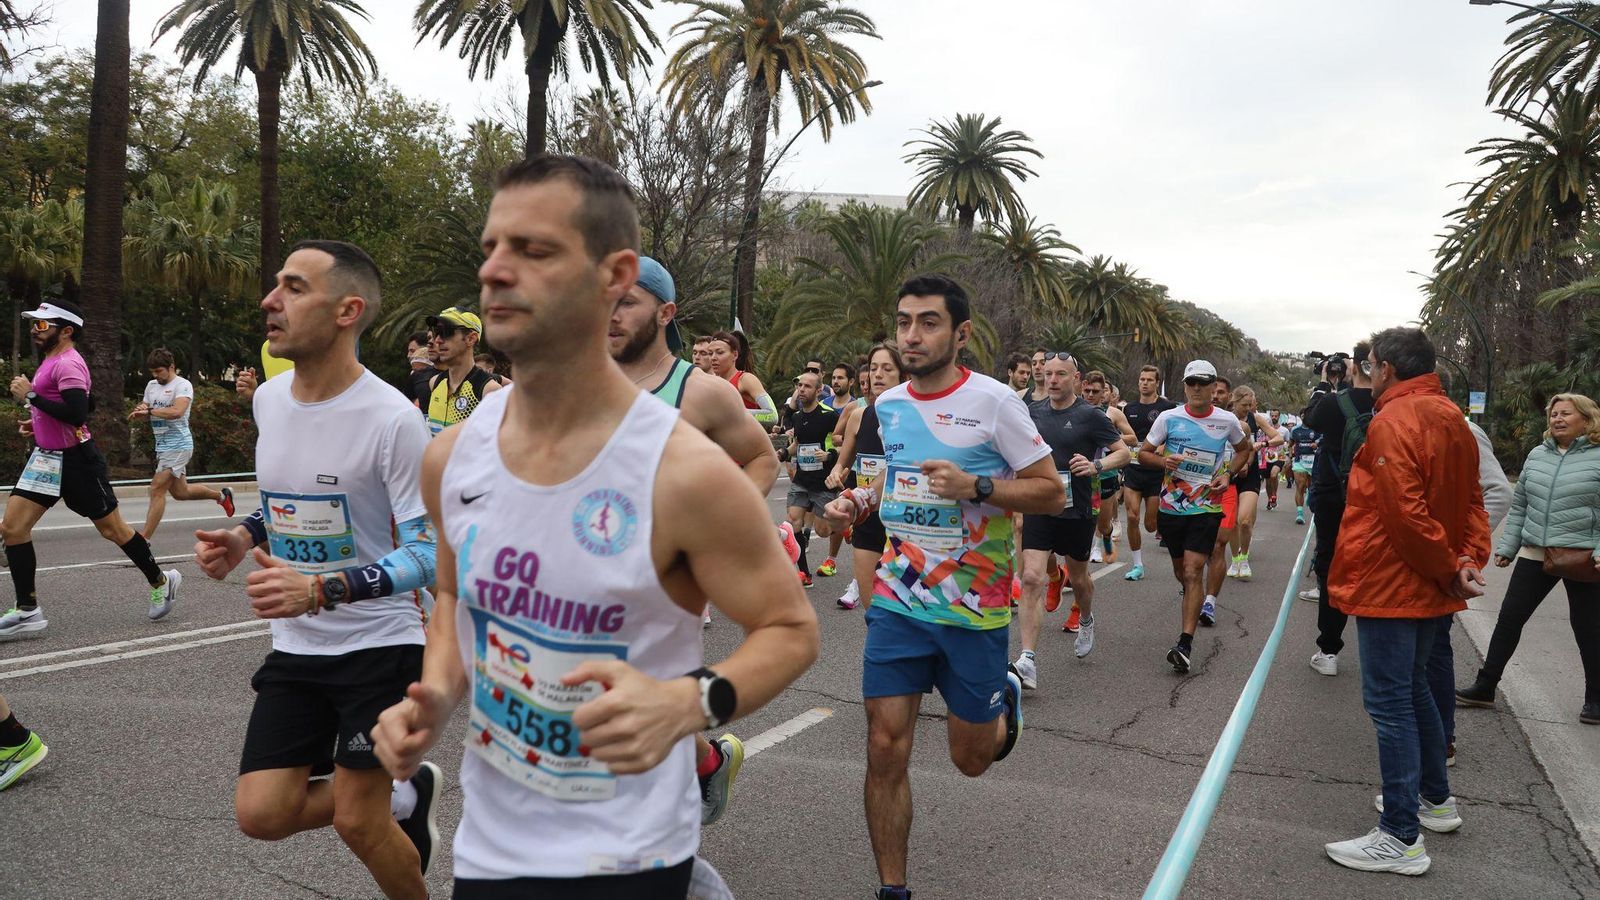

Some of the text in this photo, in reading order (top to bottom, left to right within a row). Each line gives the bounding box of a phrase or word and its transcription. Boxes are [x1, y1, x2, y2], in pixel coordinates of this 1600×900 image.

[803, 456, 816, 464] 402
[904, 506, 940, 528] 582
[285, 538, 329, 563] 333
[475, 578, 626, 635] TRAINING
[506, 697, 571, 757] 558
[348, 743, 372, 751] adidas
